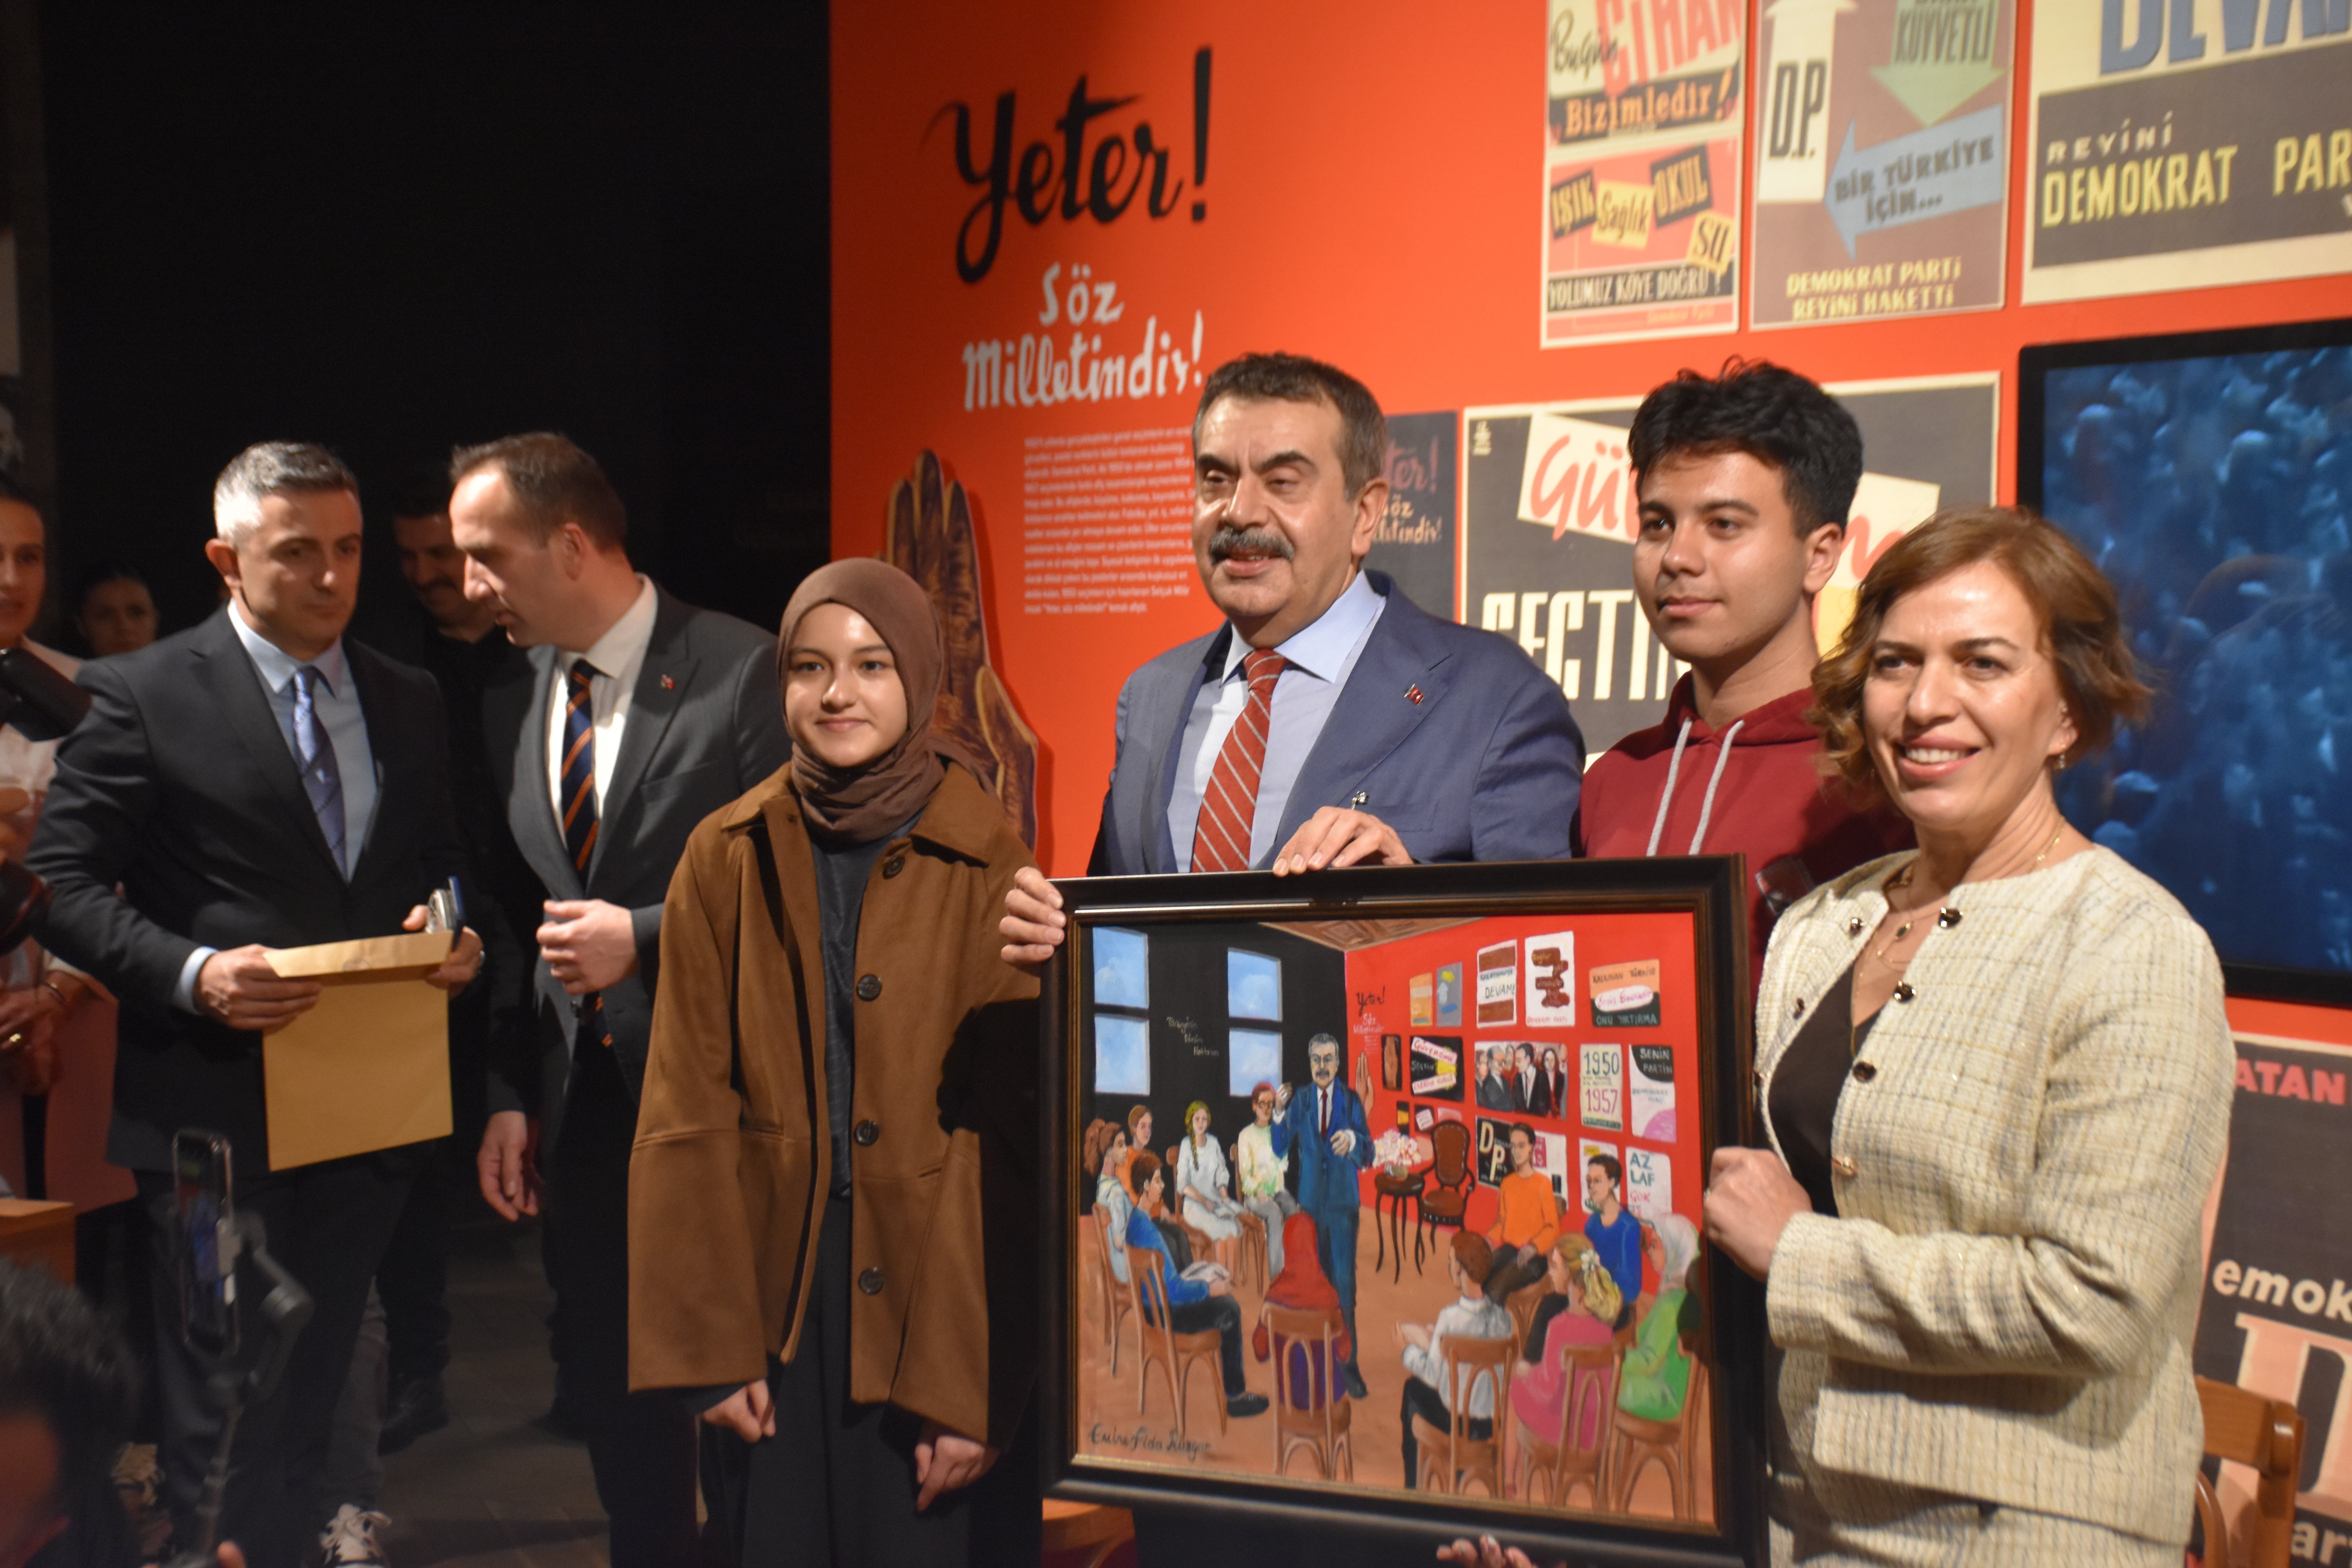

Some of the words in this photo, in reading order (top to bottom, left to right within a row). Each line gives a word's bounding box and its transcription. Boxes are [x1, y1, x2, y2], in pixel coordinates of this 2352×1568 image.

[919, 44, 1213, 284] Yeter!
[1835, 169, 1875, 201] BİR
[1884, 136, 1994, 188] TÜRKİYE
[2041, 144, 2238, 228] DEMOKRAT
[1039, 261, 1125, 326] Söz
[1786, 263, 1895, 298] DEMOKRAT
[1900, 256, 1961, 286] PARTİ
[1584, 1052, 1619, 1075] 1950
[2236, 1058, 2346, 1106] ATAN
[1586, 1088, 1618, 1115] 1957
